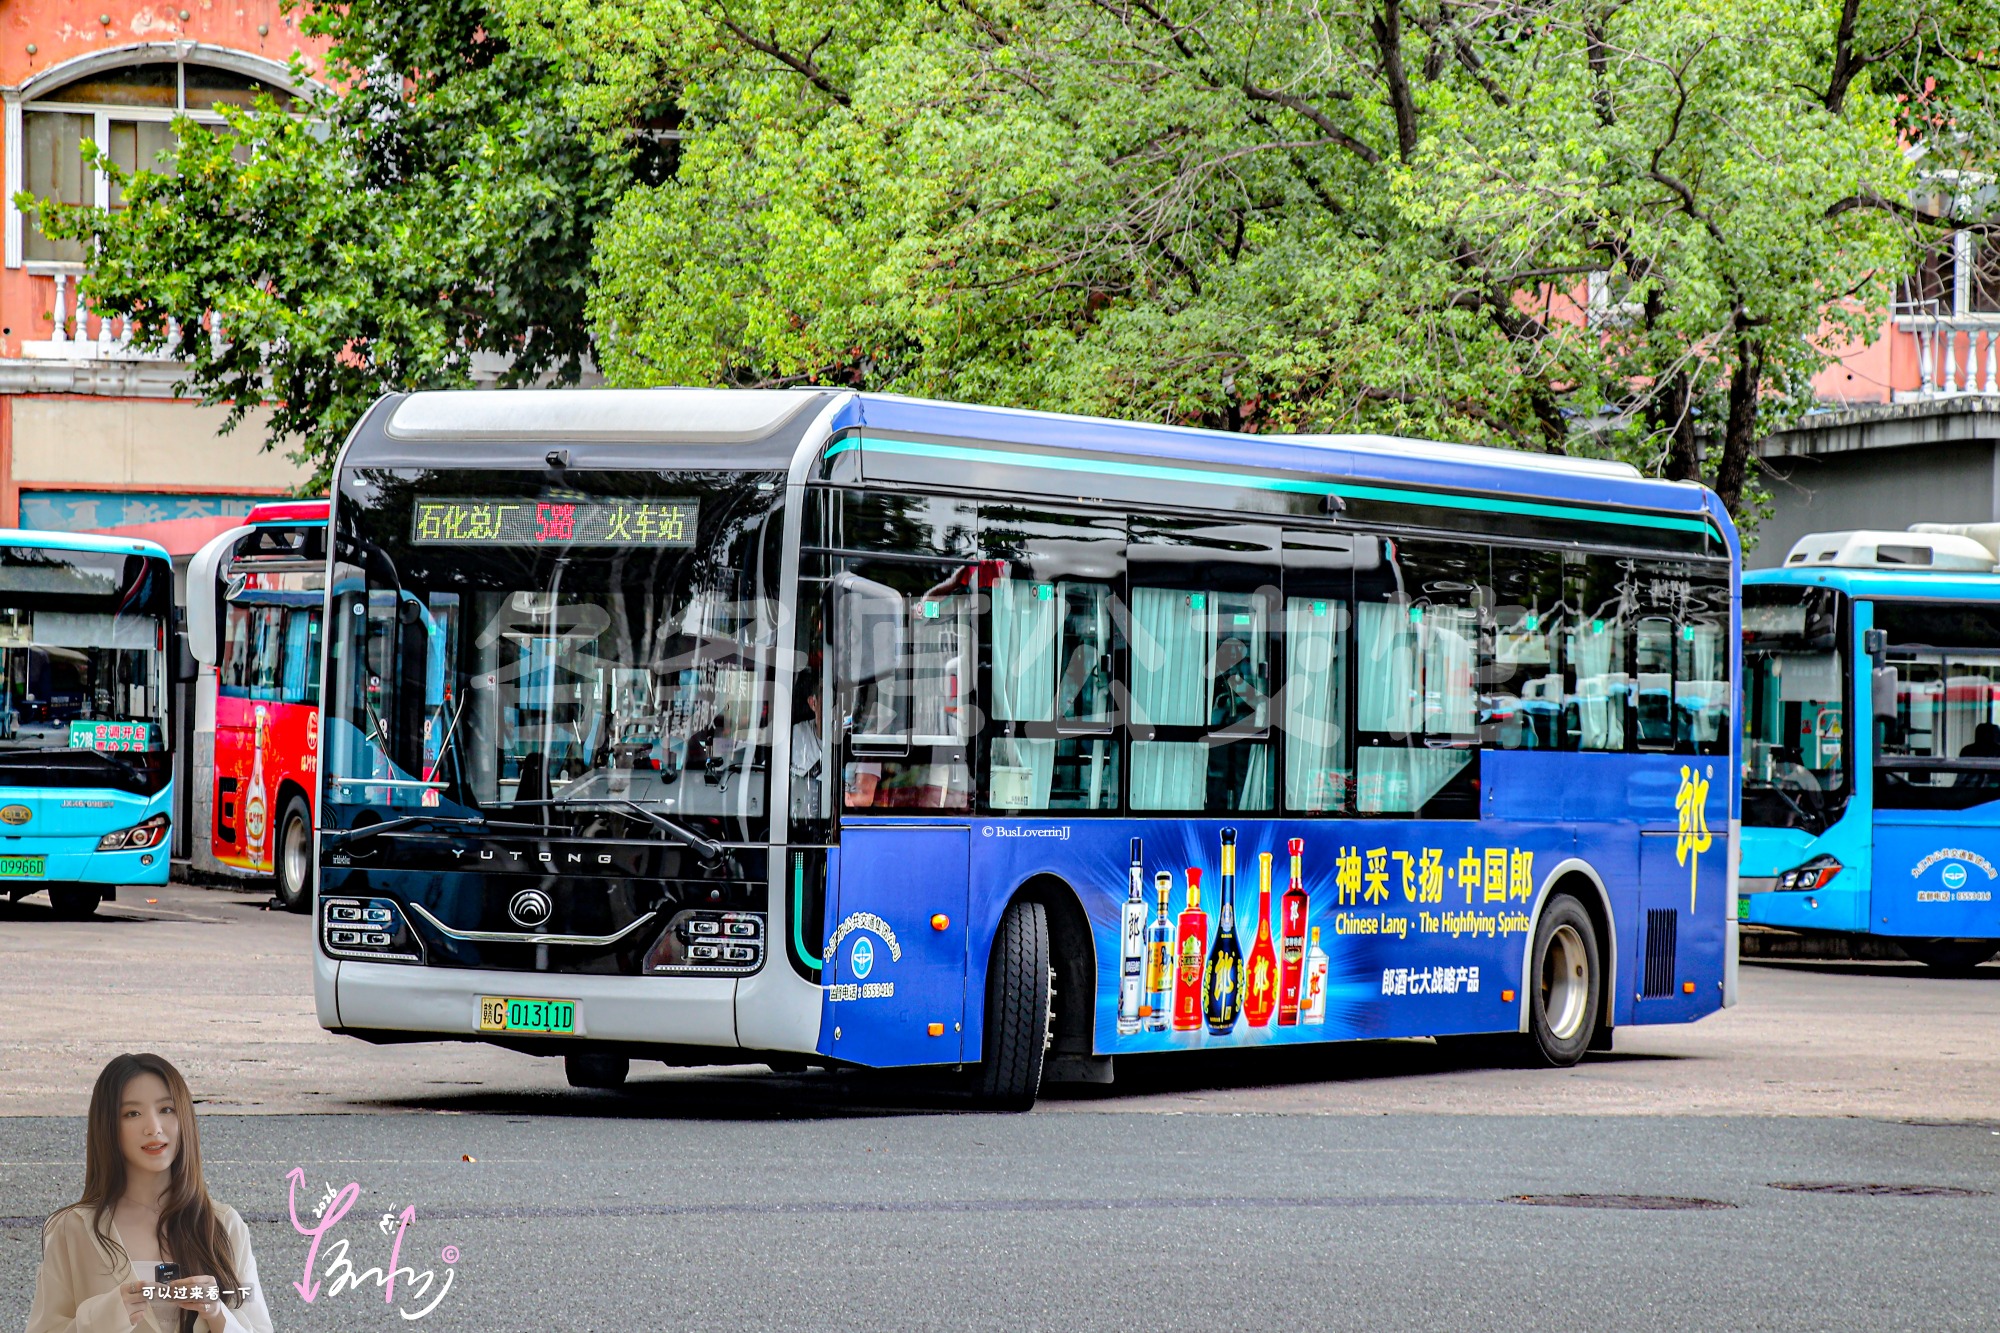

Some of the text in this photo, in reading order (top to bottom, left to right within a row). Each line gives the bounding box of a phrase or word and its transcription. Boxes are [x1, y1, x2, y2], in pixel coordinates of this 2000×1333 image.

[420, 503, 685, 542] 石化总厂 5路 火车站
[95, 724, 146, 740] 空调开启
[0, 860, 44, 874] 09966D
[452, 849, 612, 864] YUTONG
[1335, 910, 1530, 940] Chinese Lang The Highflying Spirits
[1382, 966, 1480, 996] 郎酒七大战略产品
